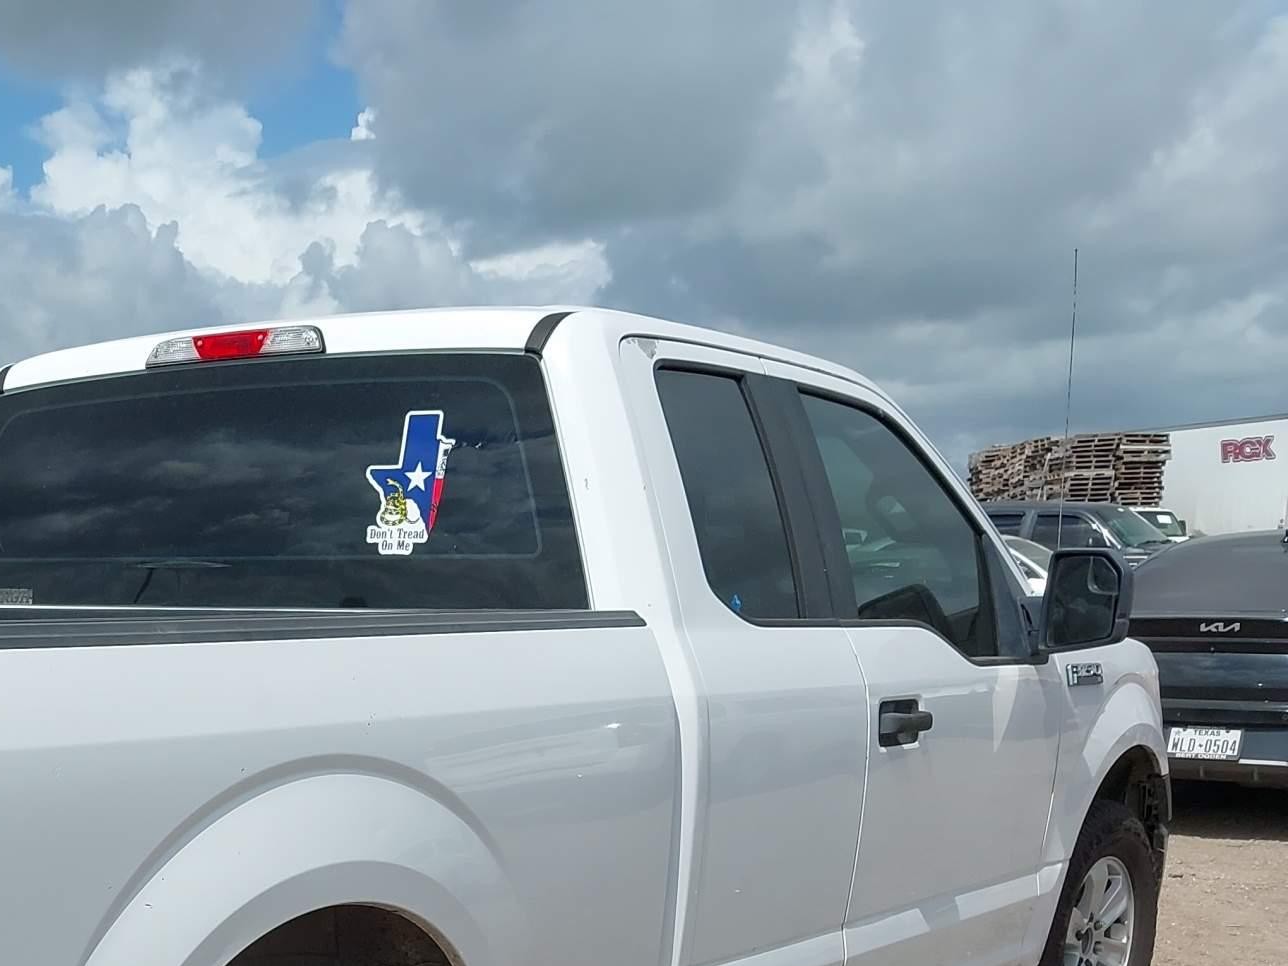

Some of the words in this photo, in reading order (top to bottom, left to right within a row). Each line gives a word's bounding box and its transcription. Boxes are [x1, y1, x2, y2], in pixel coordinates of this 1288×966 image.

[369, 529, 394, 540] Don't
[396, 529, 425, 540] Tread
[381, 541, 394, 551] On
[396, 541, 411, 551] Me
[1199, 622, 1241, 633] KIA
[1192, 728, 1221, 737] TEXAS
